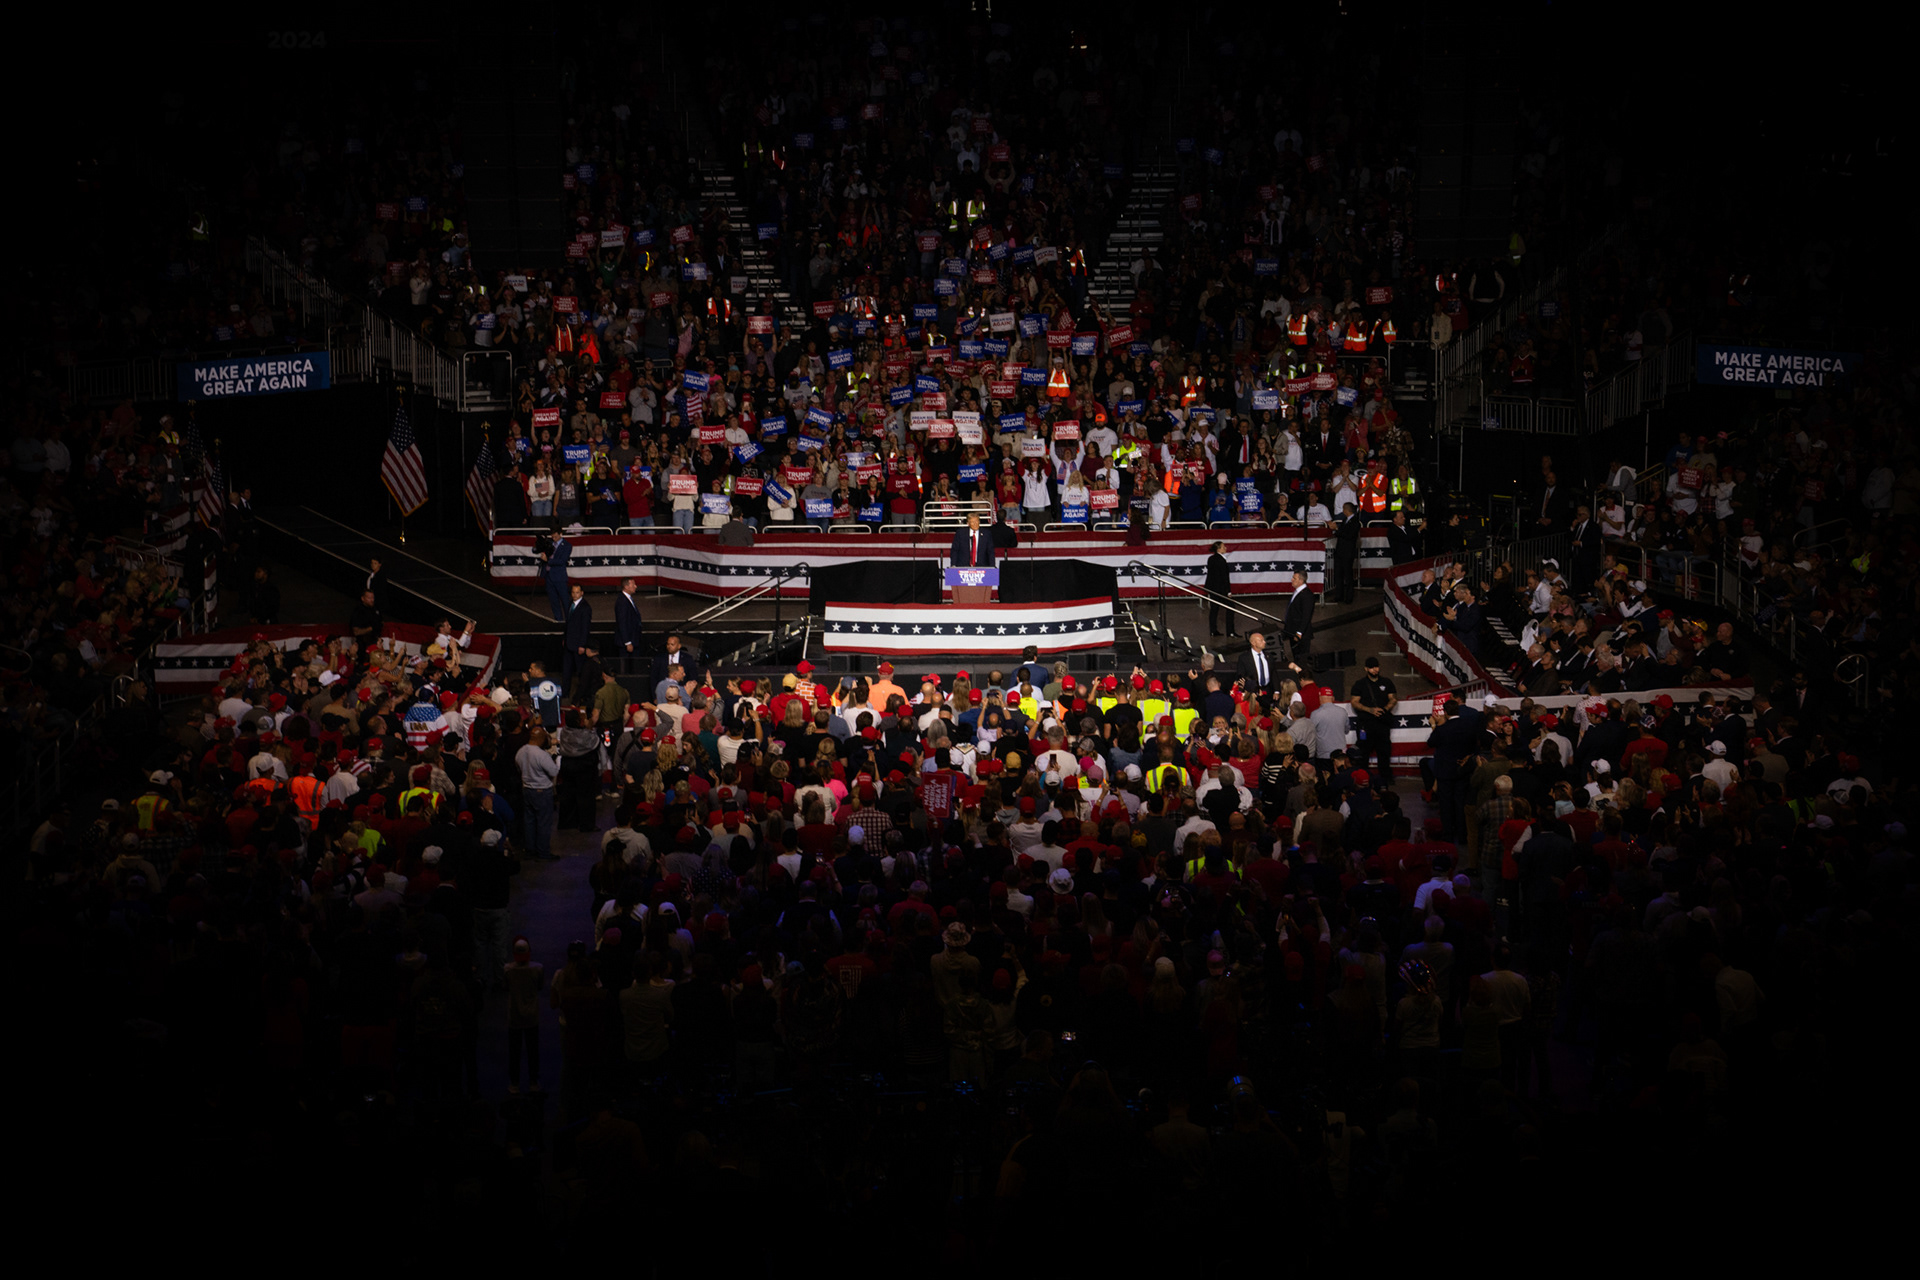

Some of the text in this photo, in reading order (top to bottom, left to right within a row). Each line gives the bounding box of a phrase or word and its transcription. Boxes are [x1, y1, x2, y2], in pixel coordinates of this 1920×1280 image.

[267, 30, 328, 50] 2024
[1110, 330, 1132, 342] TRUMP
[194, 358, 314, 382] MAKE AMERICA
[1714, 352, 1845, 373] MAKE AMERICA
[202, 374, 307, 396] GREAT AGAIN
[1722, 367, 1829, 387] GREAT AGAI
[809, 412, 832, 424] TRUMP
